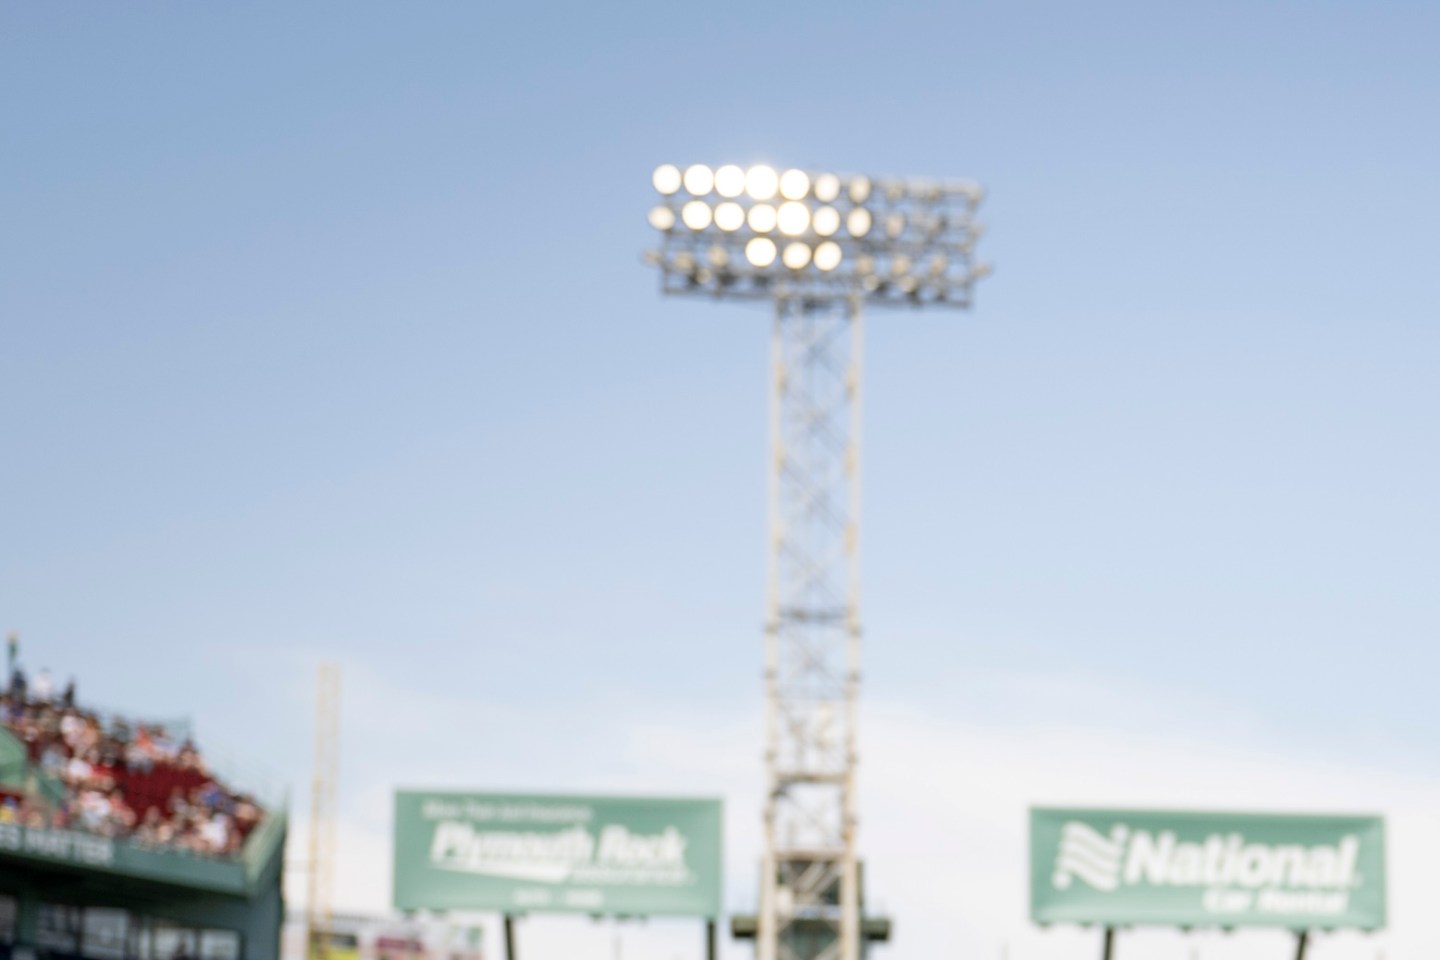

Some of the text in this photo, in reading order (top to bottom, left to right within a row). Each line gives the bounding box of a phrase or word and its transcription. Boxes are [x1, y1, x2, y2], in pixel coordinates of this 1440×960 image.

[430, 820, 690, 868] Plymouth Rock
[1124, 830, 1360, 888] National
